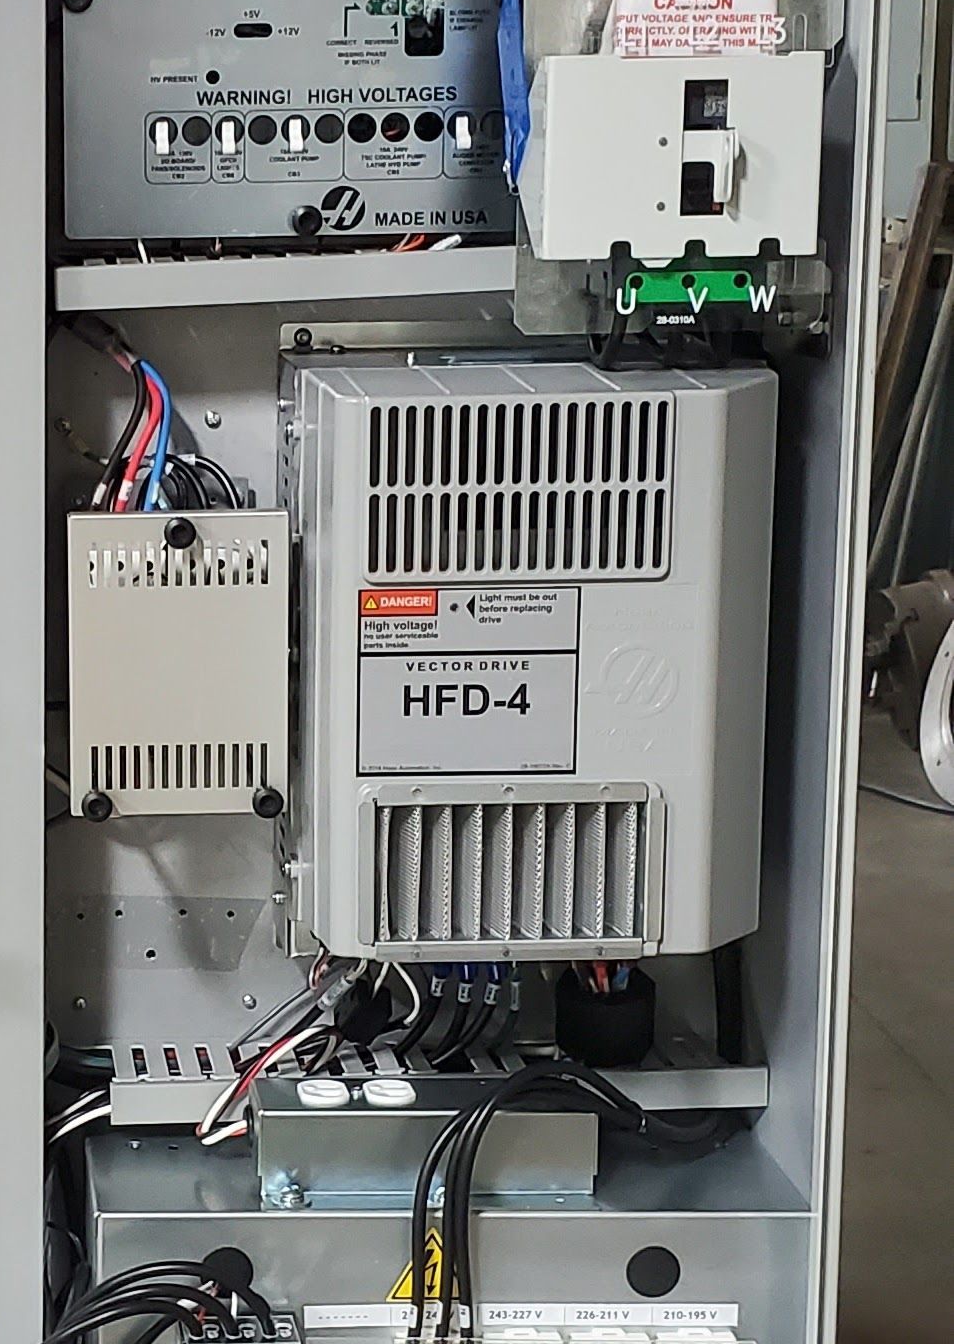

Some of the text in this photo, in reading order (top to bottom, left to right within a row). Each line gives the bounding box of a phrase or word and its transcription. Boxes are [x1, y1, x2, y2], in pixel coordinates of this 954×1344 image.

[642, 14, 688, 24] VOLTAGE
[715, 14, 757, 23] ENSURE
[162, 75, 199, 84] PRESENT
[197, 86, 458, 107] WARNING! HIGH VOLTAGES
[374, 153, 406, 161] COOLANT
[375, 210, 488, 227] MADE IN USA
[615, 285, 777, 315] U V W
[379, 593, 558, 608] DANGER! Light must be out
[478, 603, 553, 614] before replacing
[478, 615, 502, 624] drive
[364, 619, 438, 633] High voltage!
[405, 660, 531, 672] VECTOR DRIVE
[402, 682, 532, 718] HFD-4
[488, 1309, 544, 1321] 243-227 V
[575, 1309, 630, 1321] 226-211 V
[662, 1309, 718, 1321] 210-195 V
